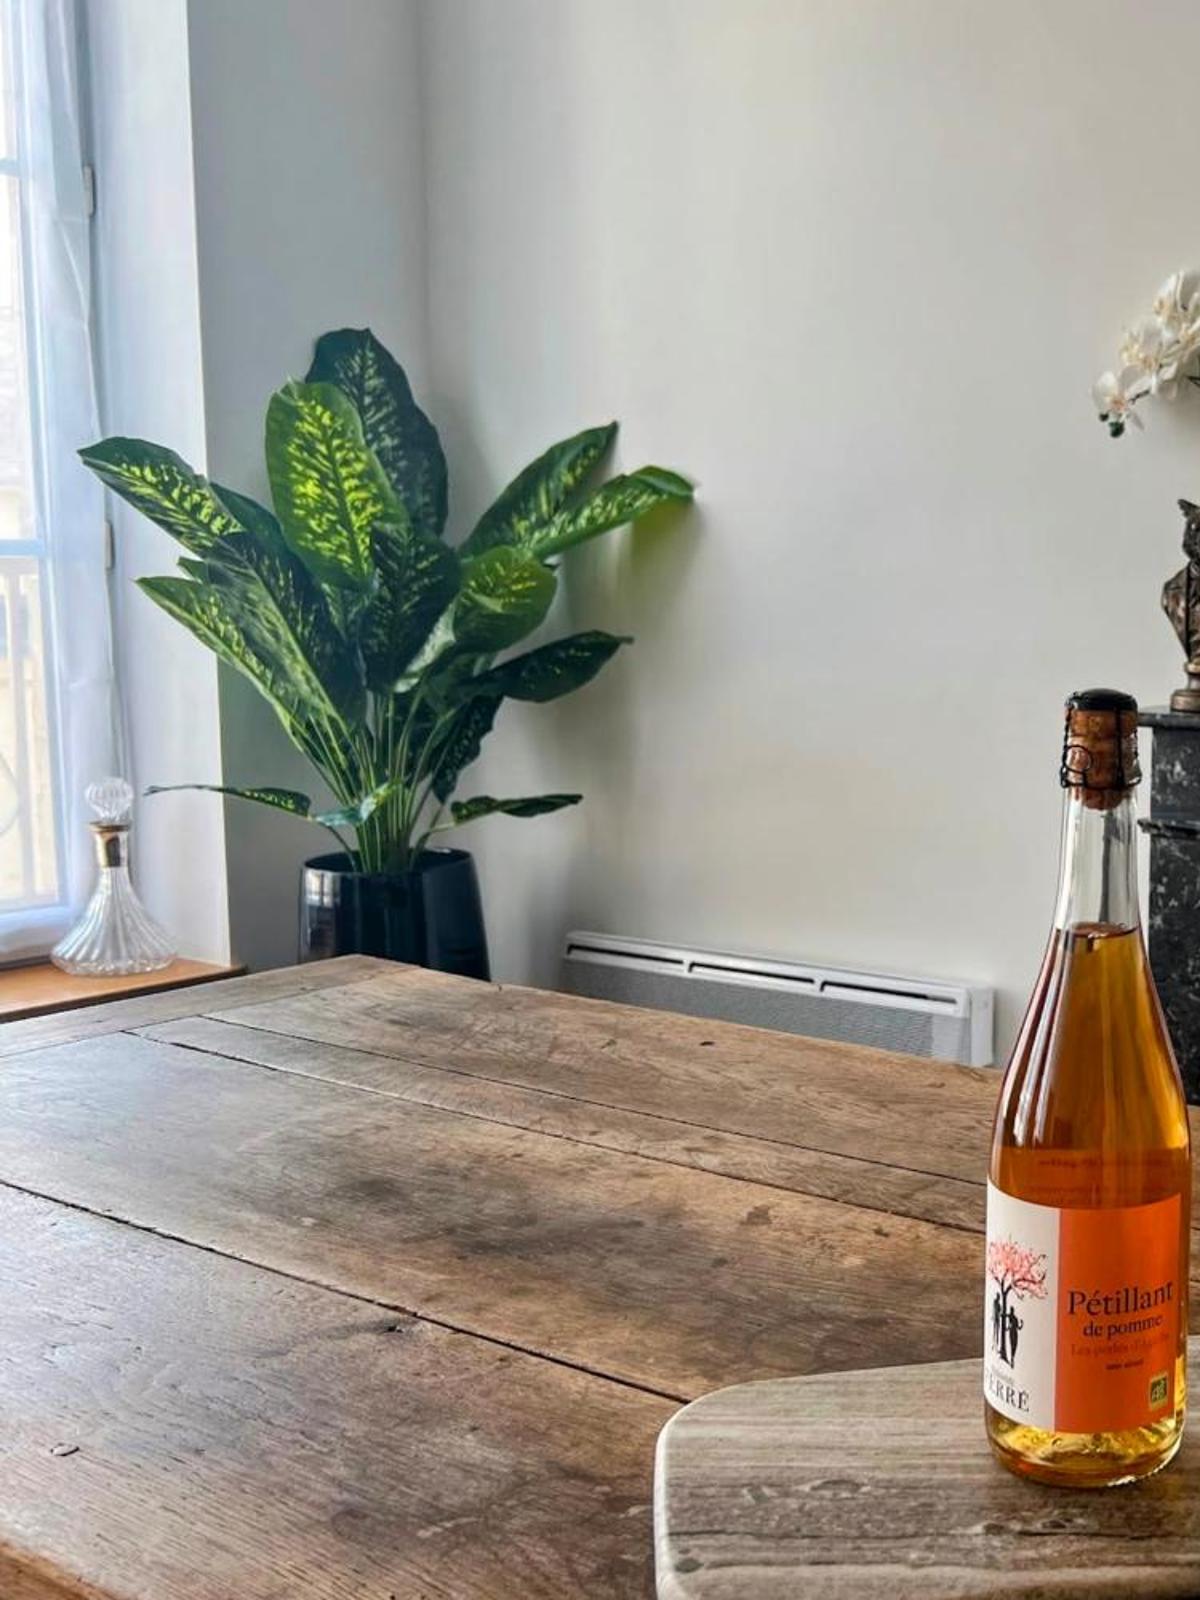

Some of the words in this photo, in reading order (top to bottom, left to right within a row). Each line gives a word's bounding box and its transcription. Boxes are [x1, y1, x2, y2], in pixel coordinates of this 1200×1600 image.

[1067, 1281, 1173, 1316] Pétillant
[1083, 1320, 1103, 1337] de
[1107, 1315, 1163, 1341] pomme
